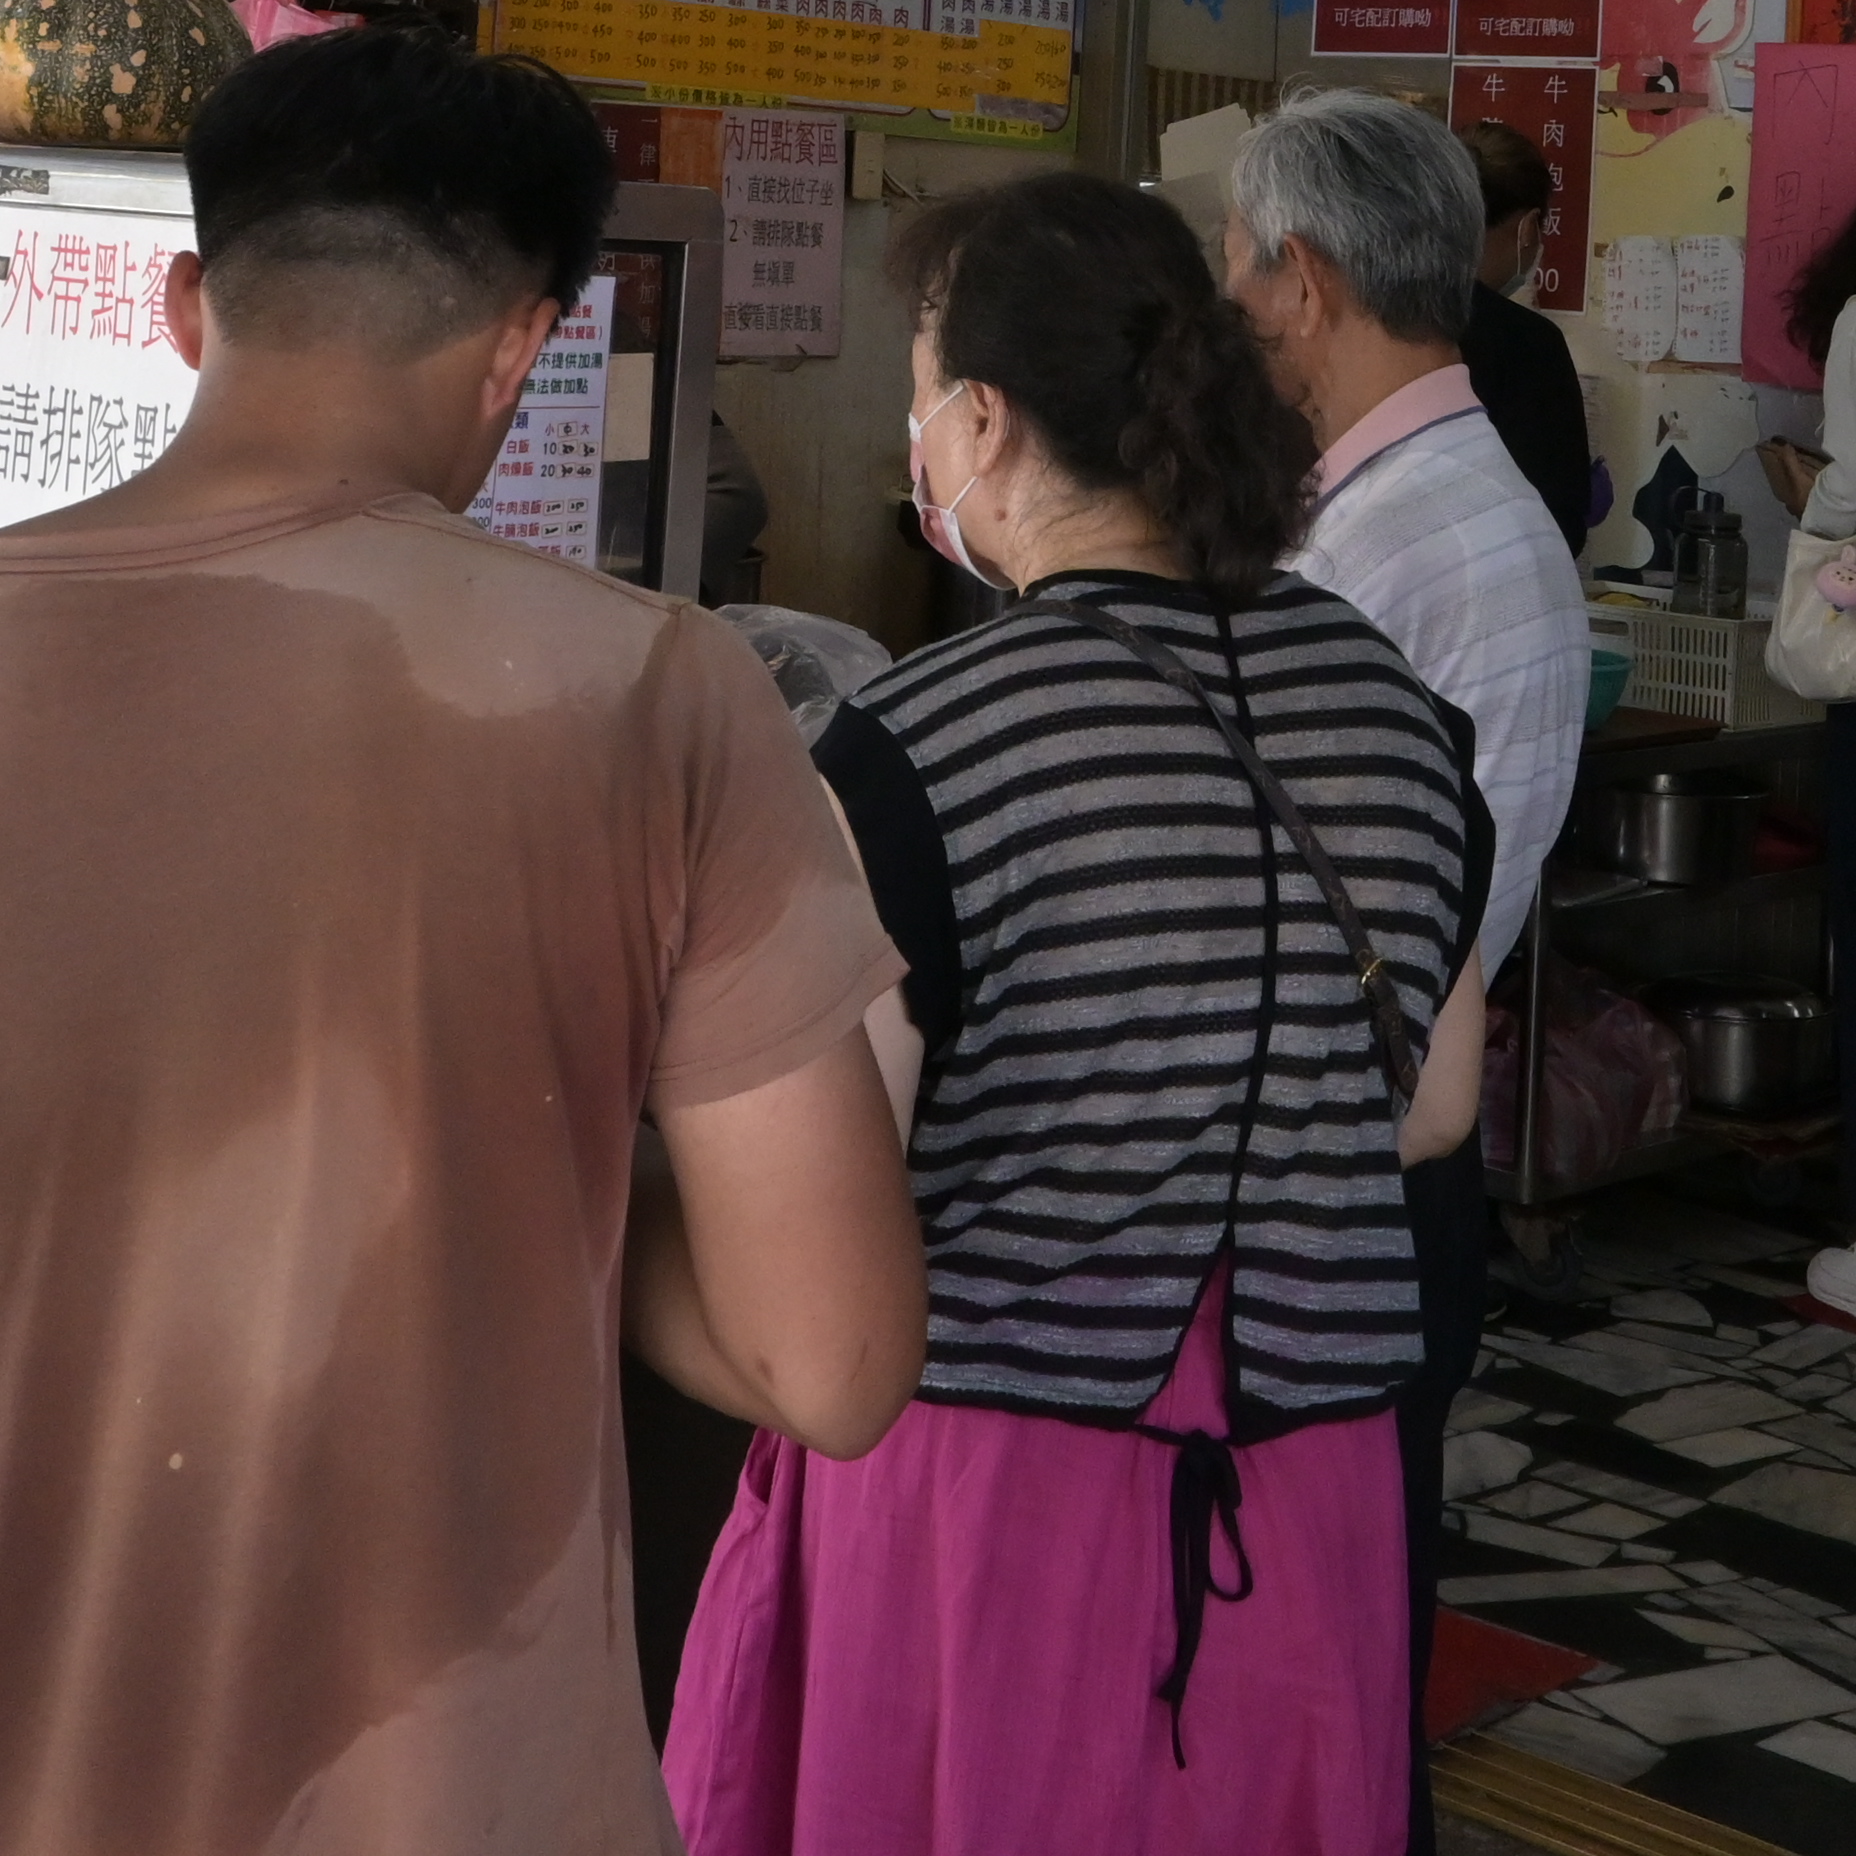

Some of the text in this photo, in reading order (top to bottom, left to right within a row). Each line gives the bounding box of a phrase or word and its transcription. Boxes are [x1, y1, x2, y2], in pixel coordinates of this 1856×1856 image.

[593, 1, 613, 14] 400
[637, 30, 657, 44] 400
[636, 54, 656, 69] 500
[724, 118, 838, 167] 內用點餐區
[1, 229, 180, 353] 外帶點餐
[532, 352, 603, 369] 不提供加湯
[545, 424, 555, 436] 小
[580, 423, 590, 435] 大
[506, 440, 529, 454] 白飯
[543, 442, 557, 455] 10
[540, 464, 555, 477] 20
[495, 500, 542, 515] 牛肉泡飯
[493, 523, 539, 538] 牛腩泡飯
